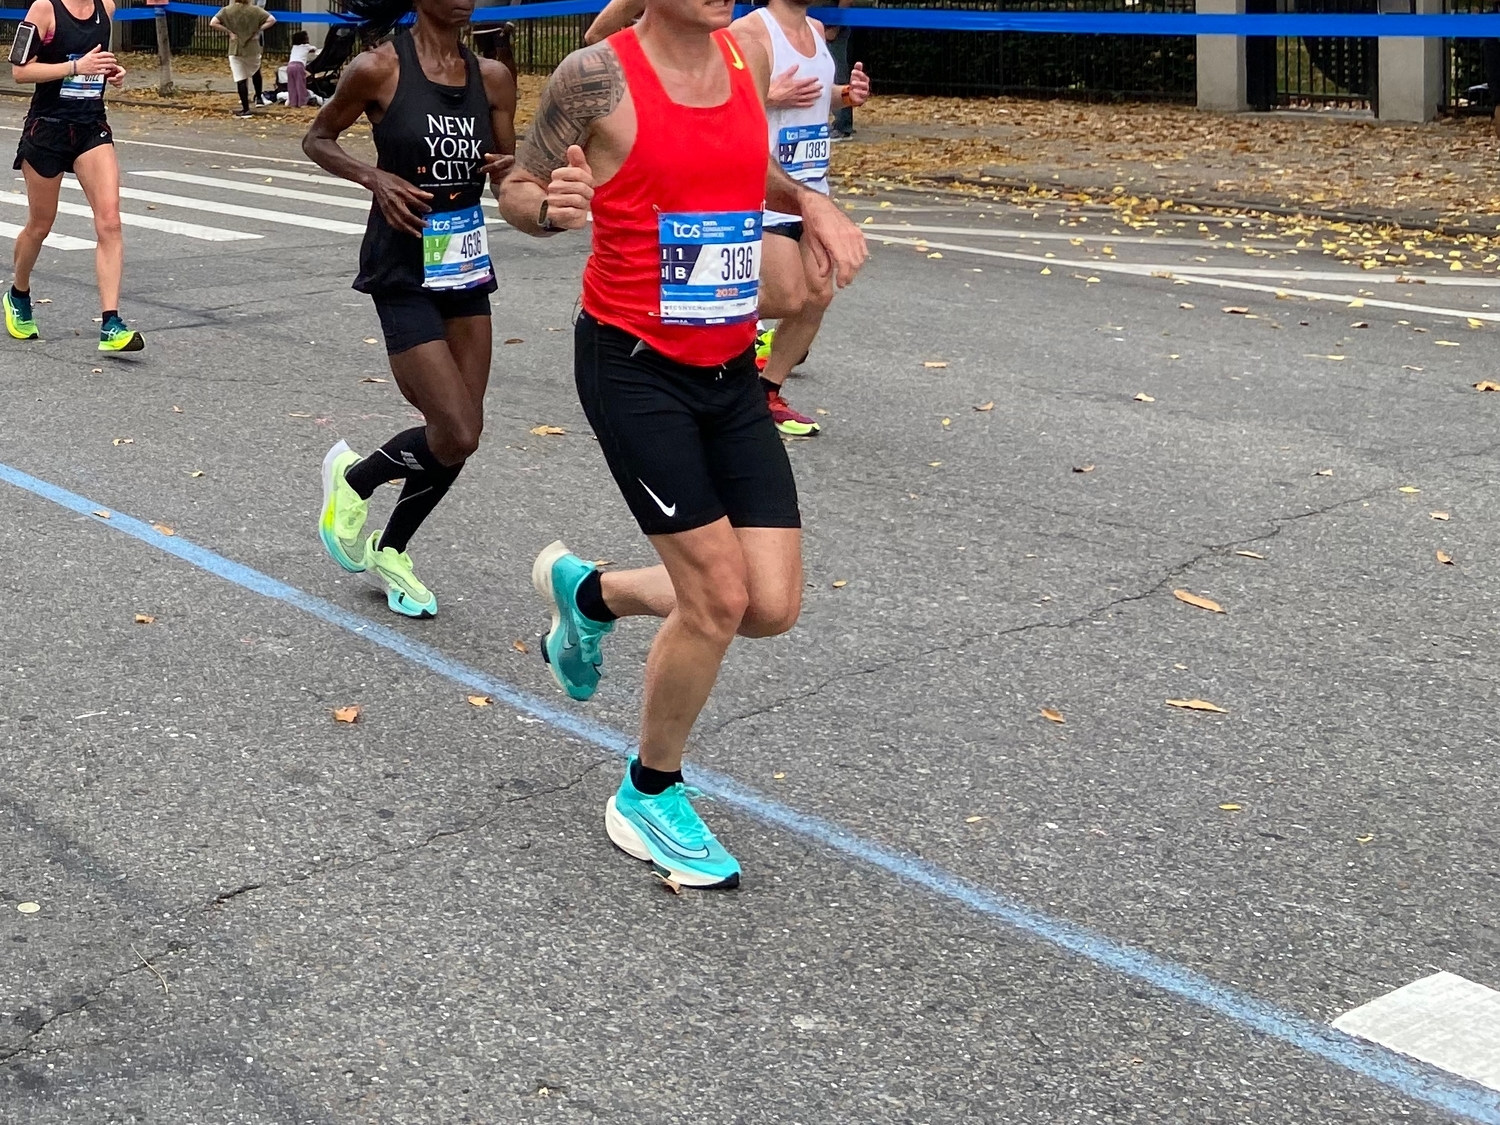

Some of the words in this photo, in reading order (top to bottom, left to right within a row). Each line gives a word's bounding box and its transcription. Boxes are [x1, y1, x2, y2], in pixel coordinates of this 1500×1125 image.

[426, 113, 476, 137] NEW
[786, 130, 799, 141] tcs
[423, 136, 483, 159] YORK
[805, 140, 827, 160] 1383
[431, 159, 477, 181] CITY
[432, 219, 451, 232] tcs
[673, 221, 701, 238] tcs
[460, 230, 482, 259] 4636
[674, 266, 687, 280] B
[720, 245, 753, 281] 3136
